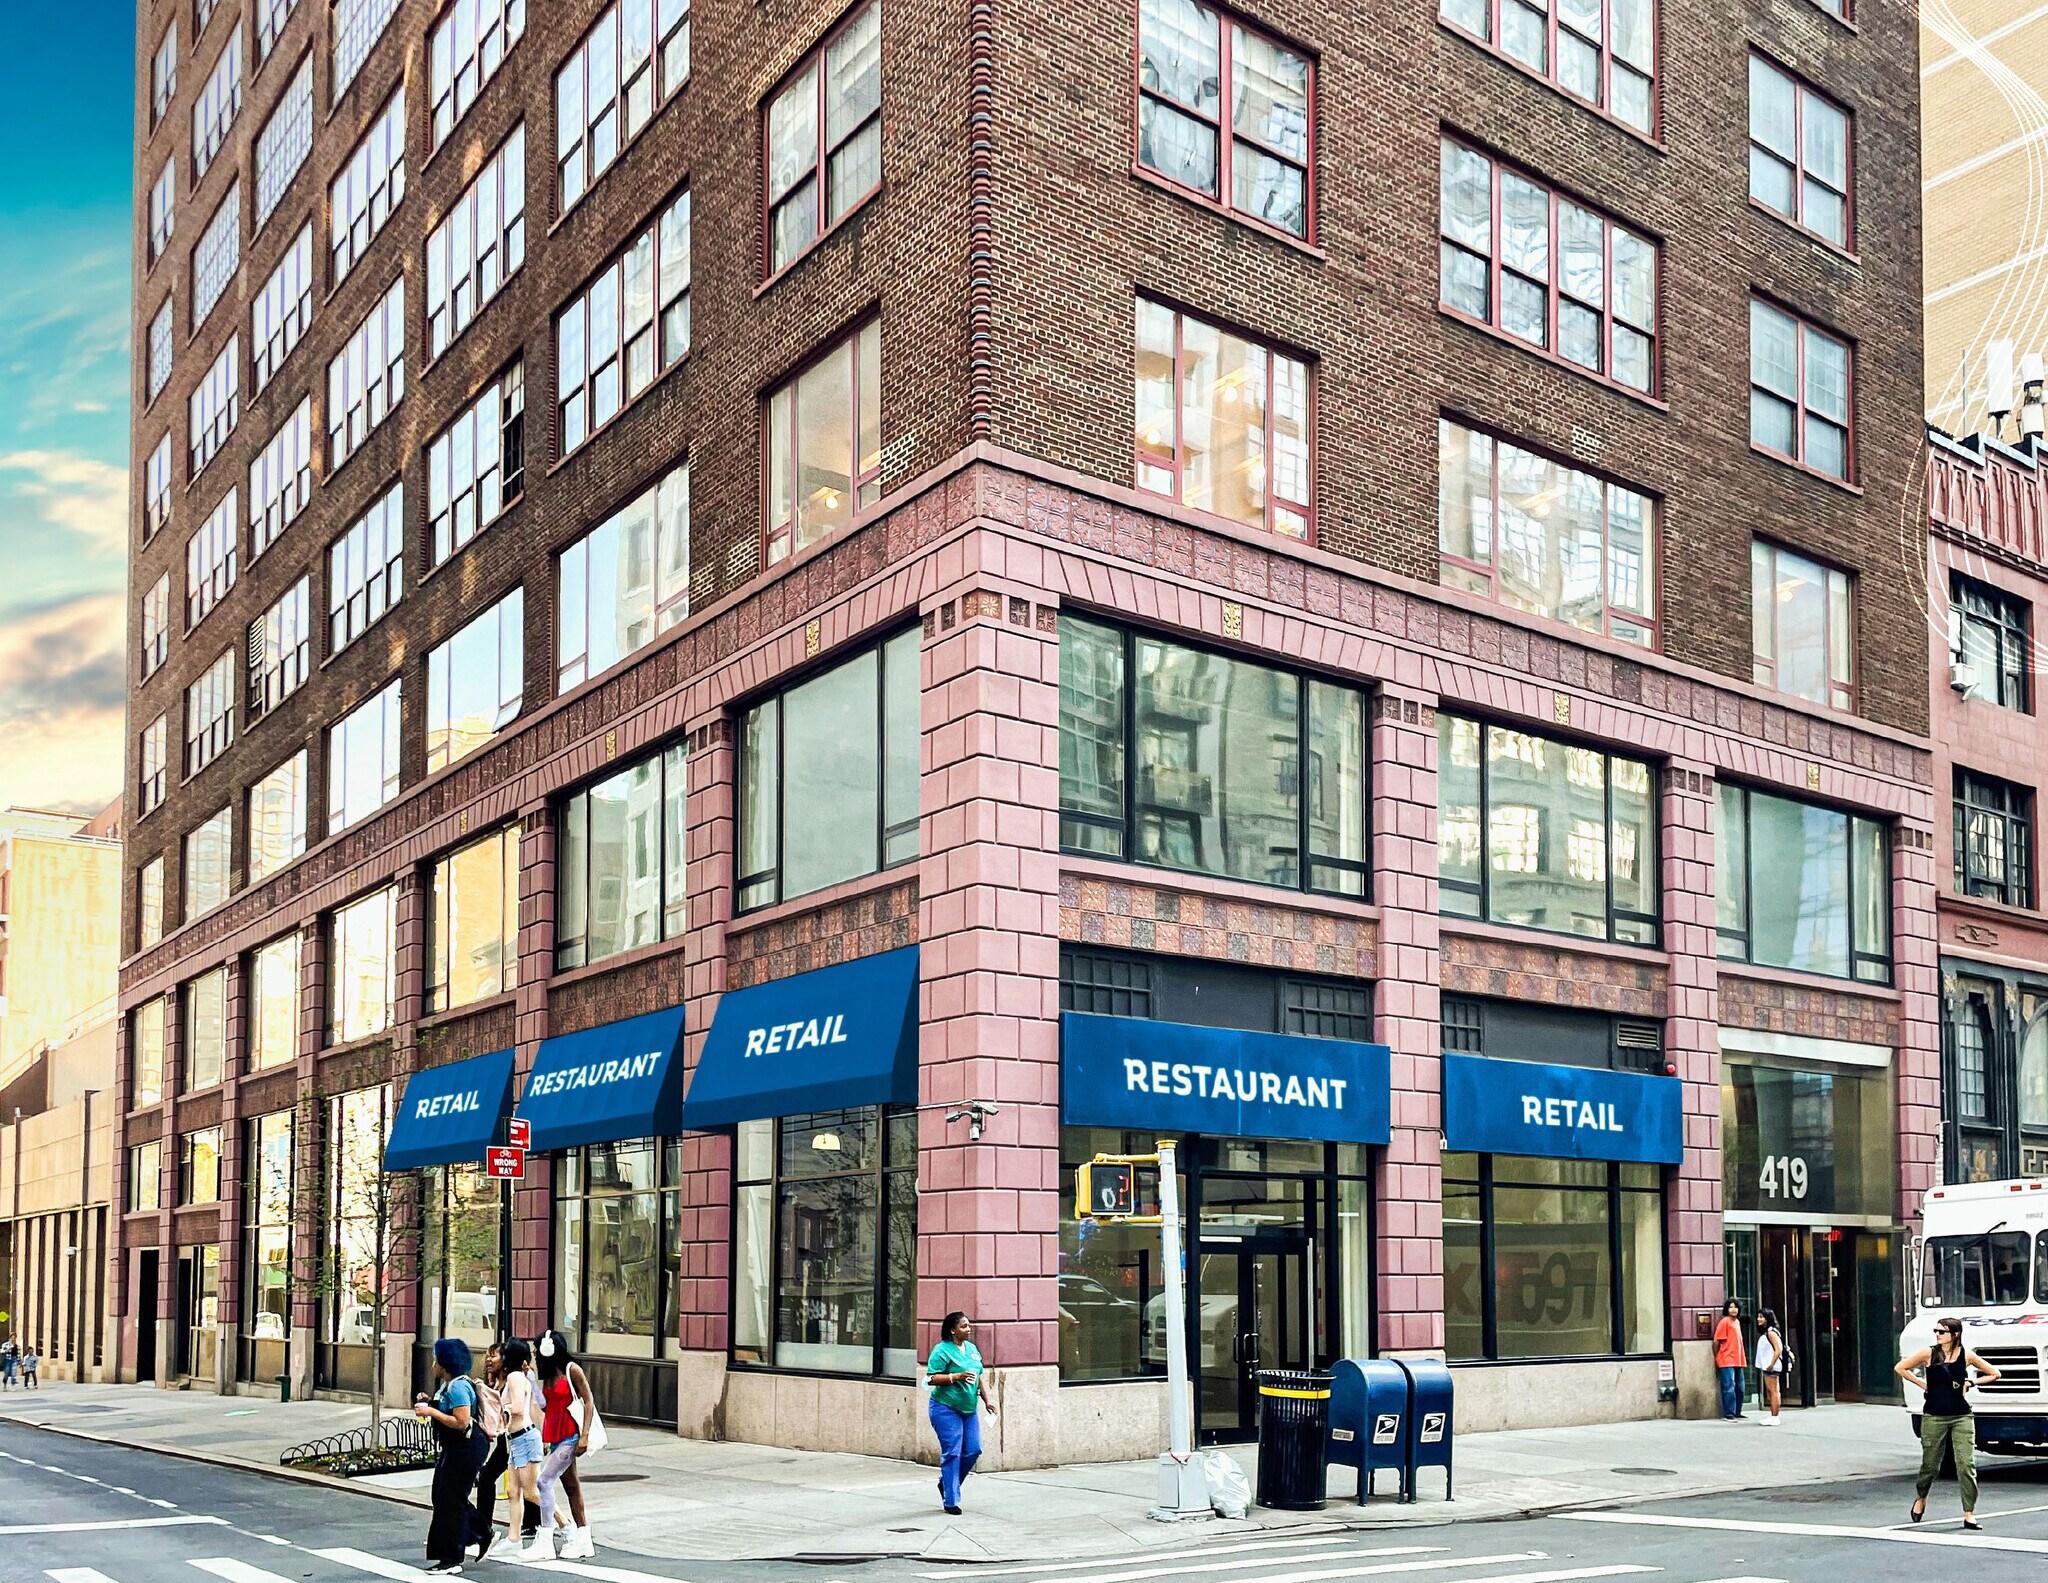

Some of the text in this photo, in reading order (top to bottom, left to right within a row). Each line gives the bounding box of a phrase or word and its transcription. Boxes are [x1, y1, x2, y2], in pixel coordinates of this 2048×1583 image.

[744, 1014, 847, 1058] RETAIL
[529, 1051, 662, 1097] RESTAURANT
[1123, 1058, 1347, 1109] RESTAURANT
[415, 1090, 480, 1119] RETAIL
[1521, 1095, 1624, 1132] RETAIL
[493, 1158, 518, 1167] WRONG
[498, 1167, 513, 1175] WAY
[1759, 1155, 1809, 1199] 419
